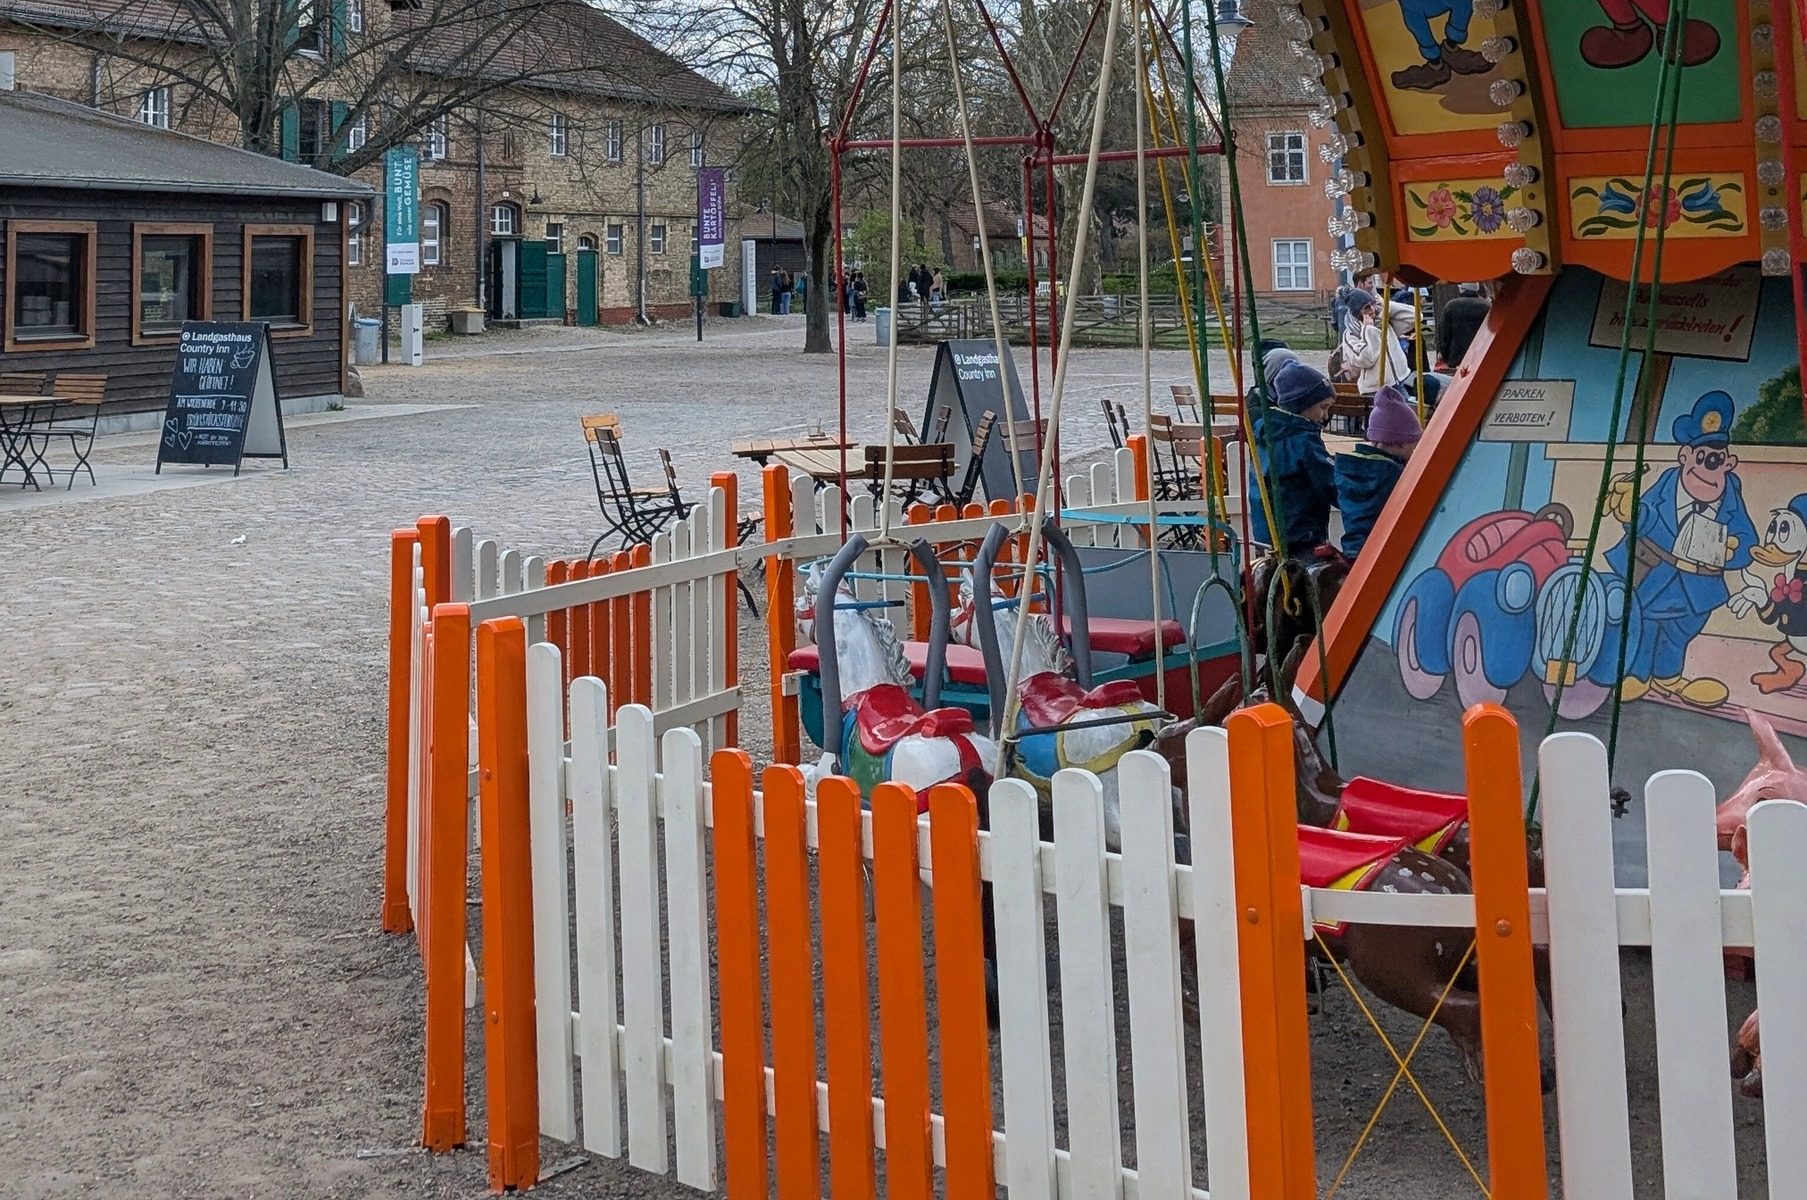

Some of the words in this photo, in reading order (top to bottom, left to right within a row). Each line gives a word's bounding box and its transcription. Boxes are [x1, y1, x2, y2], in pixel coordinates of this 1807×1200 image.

[394, 161, 403, 193] BUNT
[402, 157, 412, 206] GEMÜSE
[192, 331, 252, 344] Landgasthaus
[180, 343, 214, 355] Country
[216, 345, 230, 354] Inn
[183, 358, 197, 373] WIR
[198, 357, 224, 374] HABEN
[958, 368, 984, 381] Country
[984, 368, 997, 378] Inn
[1503, 388, 1546, 398] PARKEN
